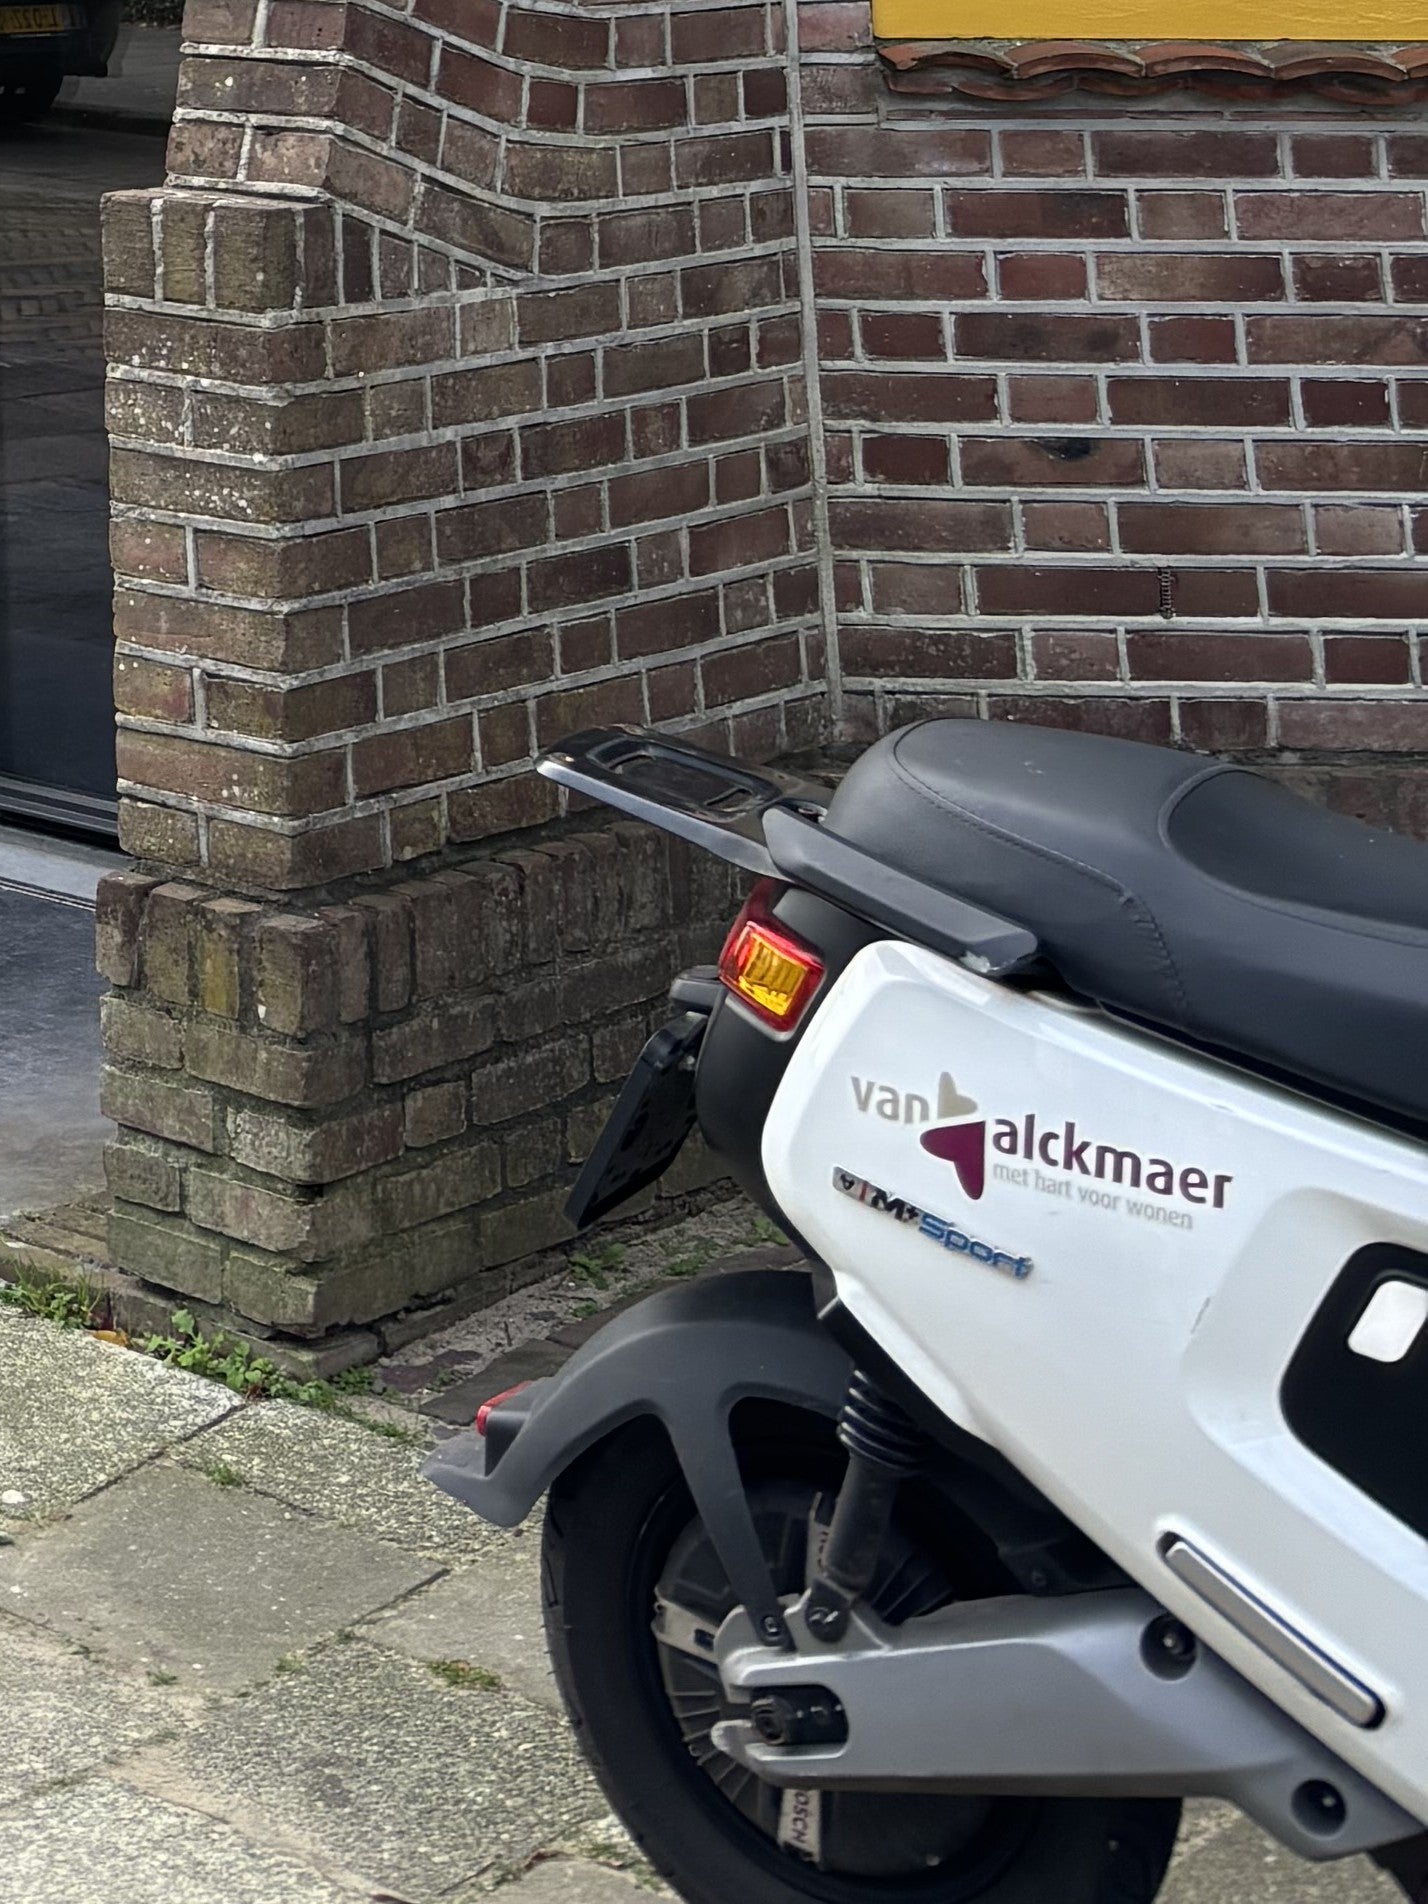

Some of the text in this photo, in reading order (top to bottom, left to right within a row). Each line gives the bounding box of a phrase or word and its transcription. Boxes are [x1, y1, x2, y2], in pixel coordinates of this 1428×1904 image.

[850, 1075, 930, 1125] van
[992, 1113, 1234, 1209] alckmaer
[992, 1162, 1195, 1231] met hart voor wonen
[792, 1790, 810, 1844] OSCH
